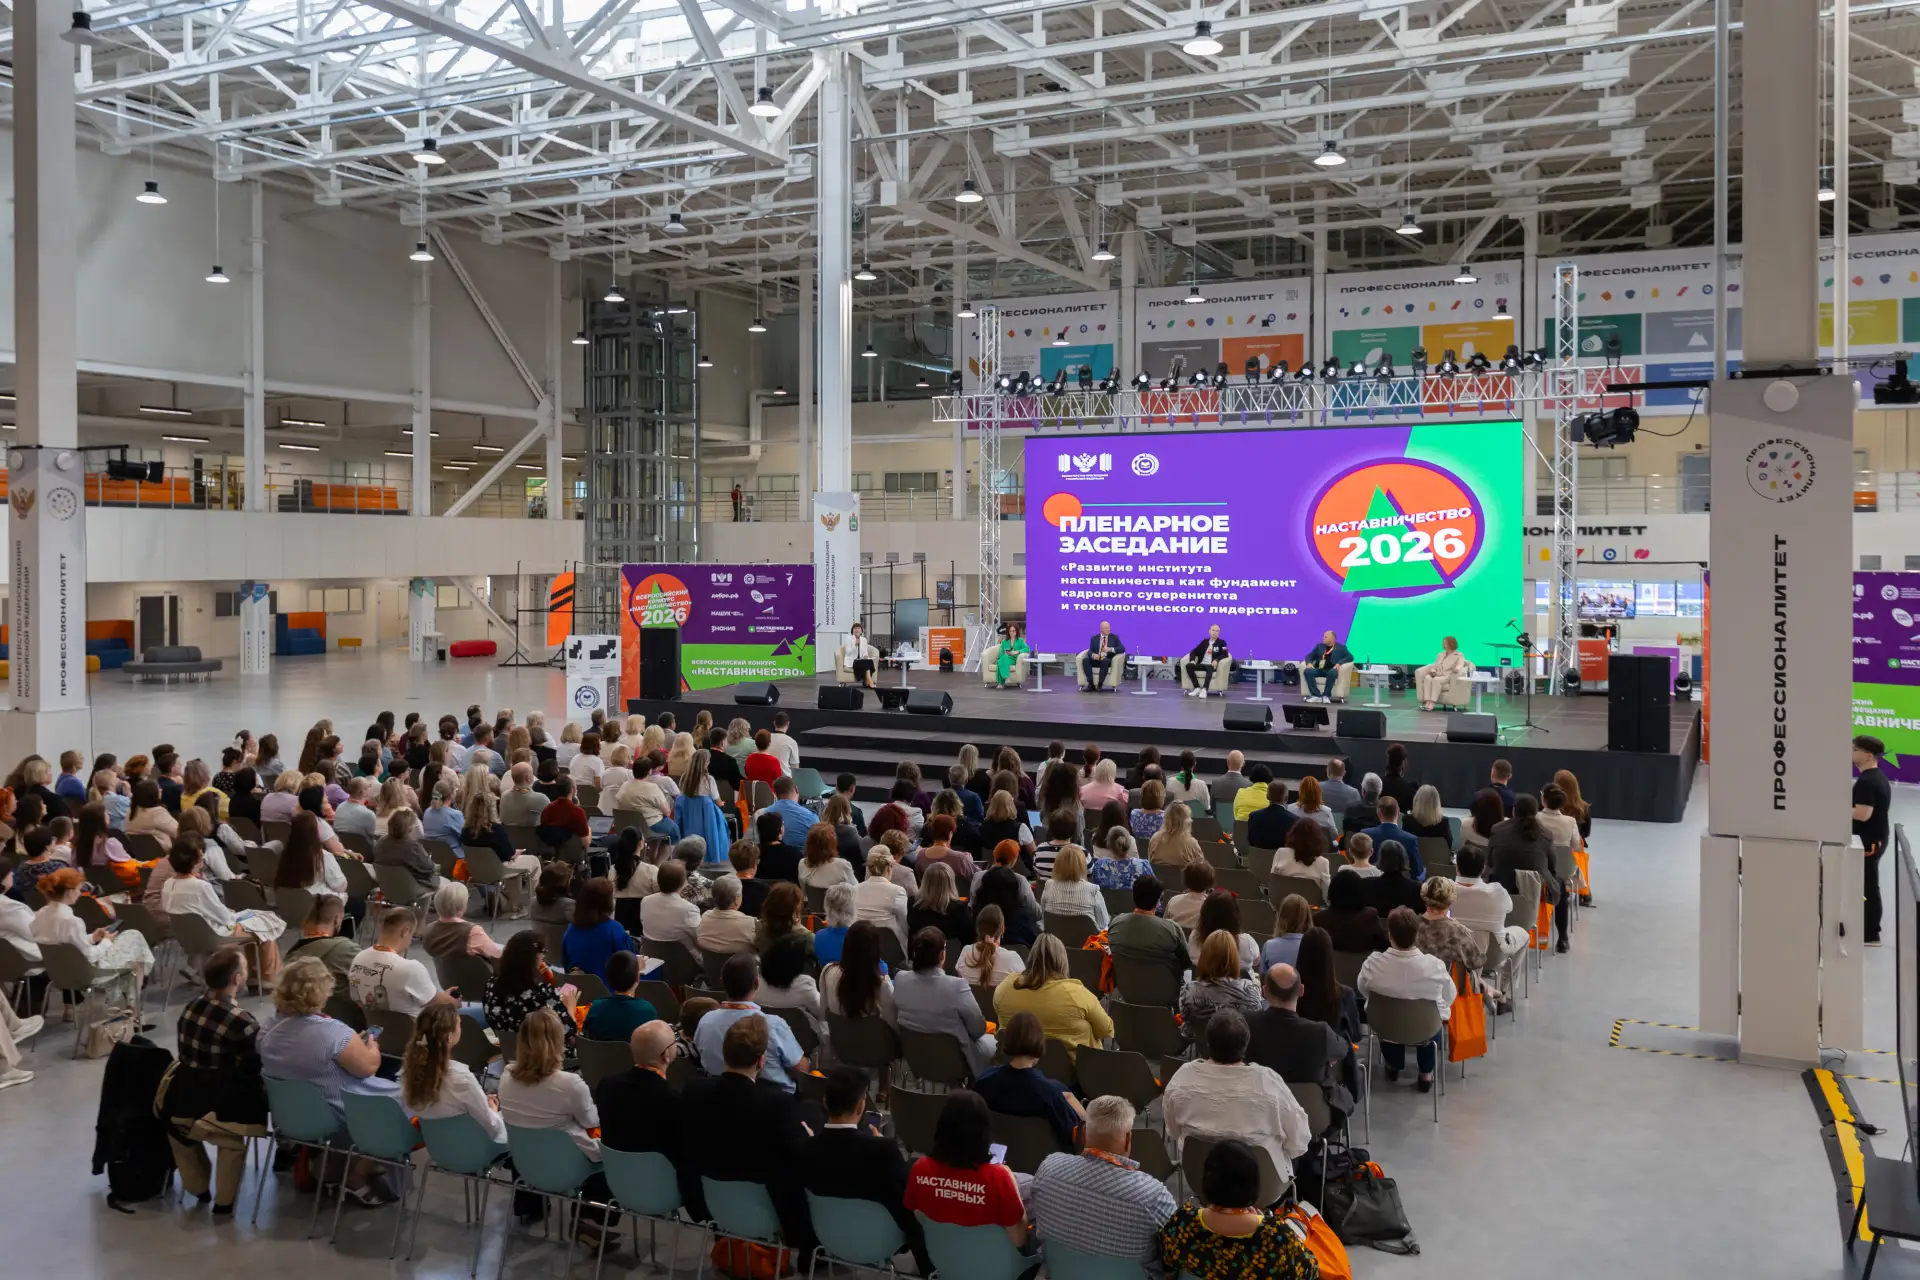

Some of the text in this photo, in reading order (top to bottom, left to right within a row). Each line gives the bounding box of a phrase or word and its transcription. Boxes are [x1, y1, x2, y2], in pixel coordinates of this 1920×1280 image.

[1553, 262, 1711, 279] ФЕССИОНАЛИТЕТ
[1340, 278, 1482, 293] ПРОФЕССИОНАЛИТ
[1746, 438, 1816, 503] ПРОФЕССИОНАЛИТЕТ
[1059, 515, 1230, 532] ПЛЕНАРНОЕ
[1315, 507, 1472, 535] НАСТАВНИЧЕСТВО
[1059, 536, 1228, 556] ЗАСЕДАНИЕ
[1338, 528, 1466, 567] 2026
[1060, 562, 1212, 574] «Развитие института
[1060, 576, 1297, 589] наставничества как фундамент
[1060, 589, 1238, 601] кадрового суверенитета
[641, 607, 687, 625] 2026
[1073, 603, 1205, 614] технологического
[1208, 605, 1298, 616] лидерства»
[691, 667, 805, 676] «НАСТАВНИЧЕСТВО»
[1773, 534, 1787, 811] ПРОФЕССИОНАЛИТЕТ
[1852, 715, 1920, 730] АВНИЧЕ
[916, 1175, 986, 1194] НАСТАВНИК
[935, 1188, 986, 1205] ПЕРВЫХ
